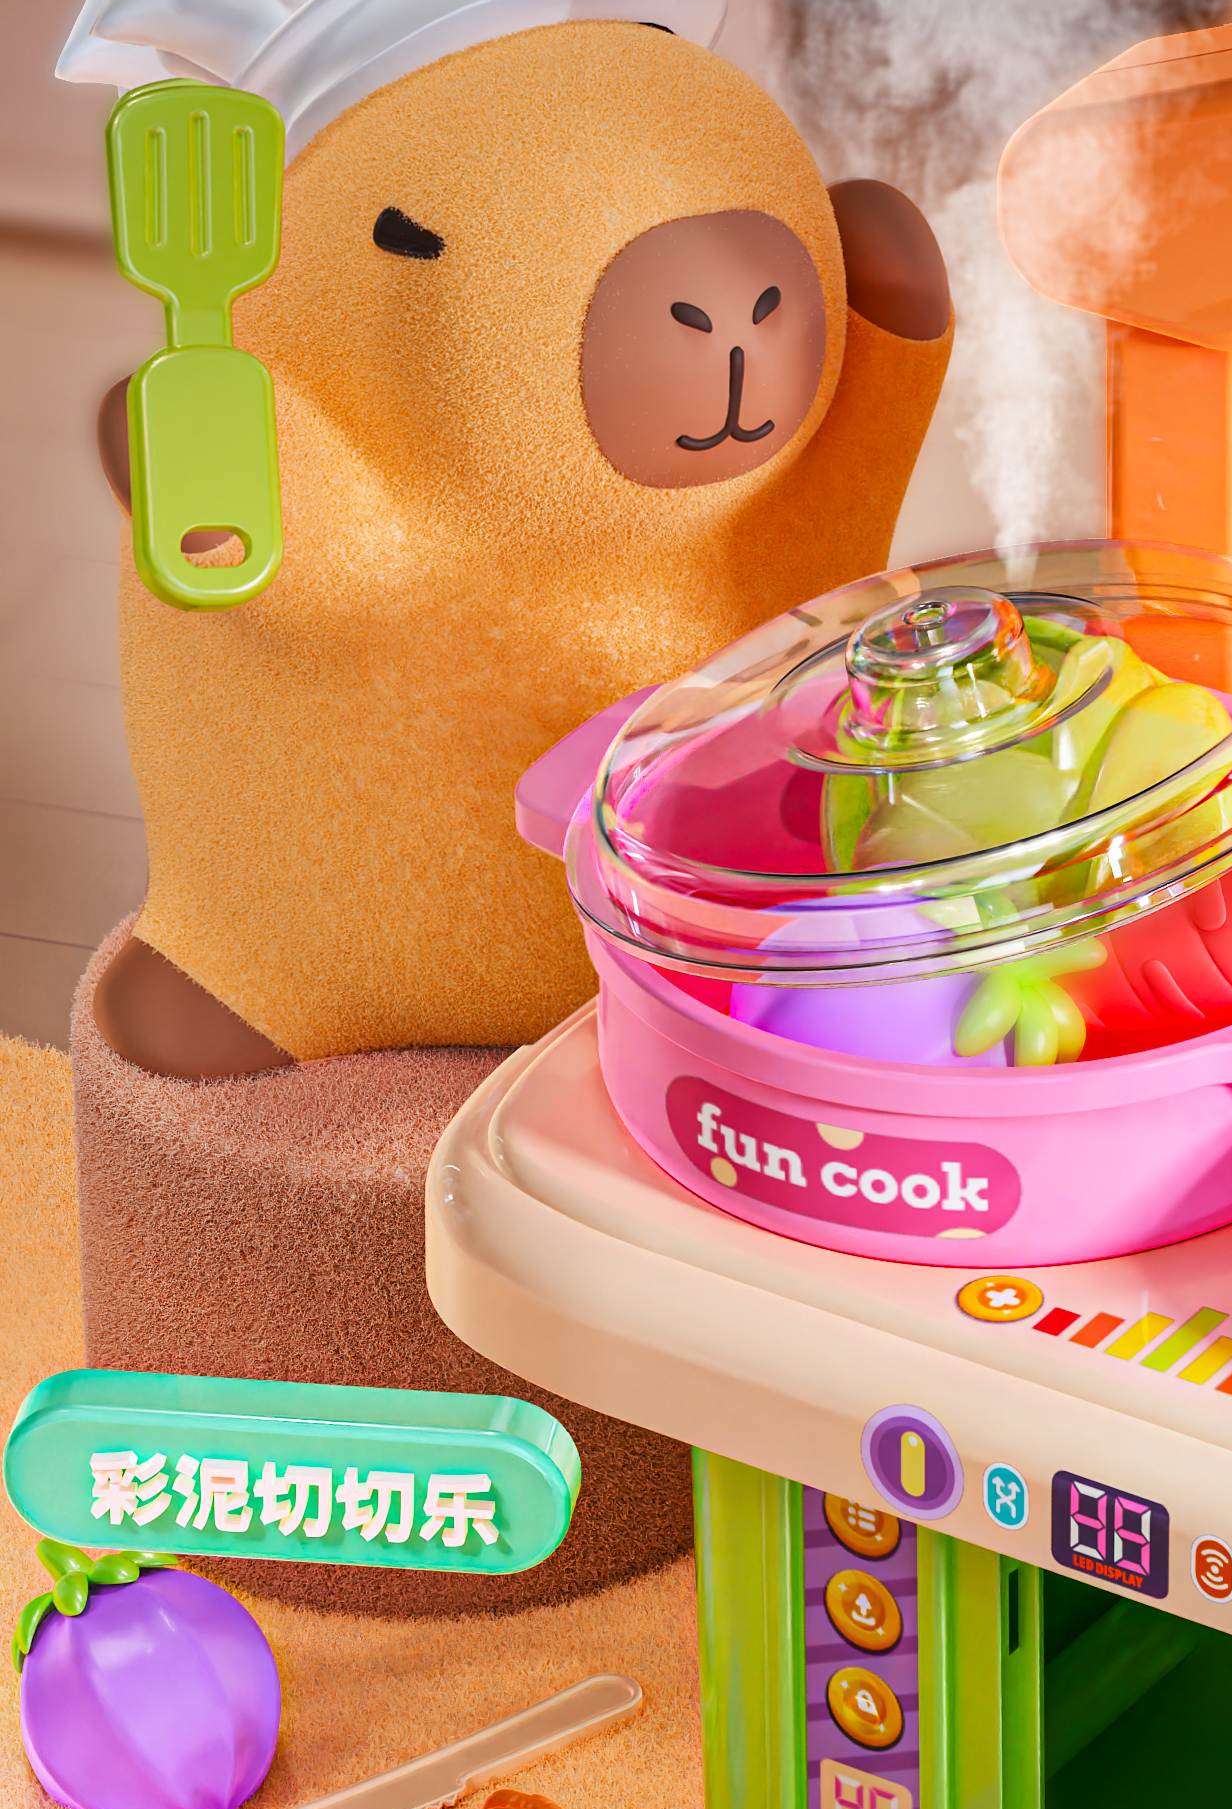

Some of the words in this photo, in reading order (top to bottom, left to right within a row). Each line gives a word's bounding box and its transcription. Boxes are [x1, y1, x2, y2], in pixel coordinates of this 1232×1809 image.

[696, 1101, 807, 1187] fun
[821, 1161, 989, 1213] cook
[1073, 1554, 1094, 1571] LED
[1096, 1562, 1144, 1589] DISPLAY
